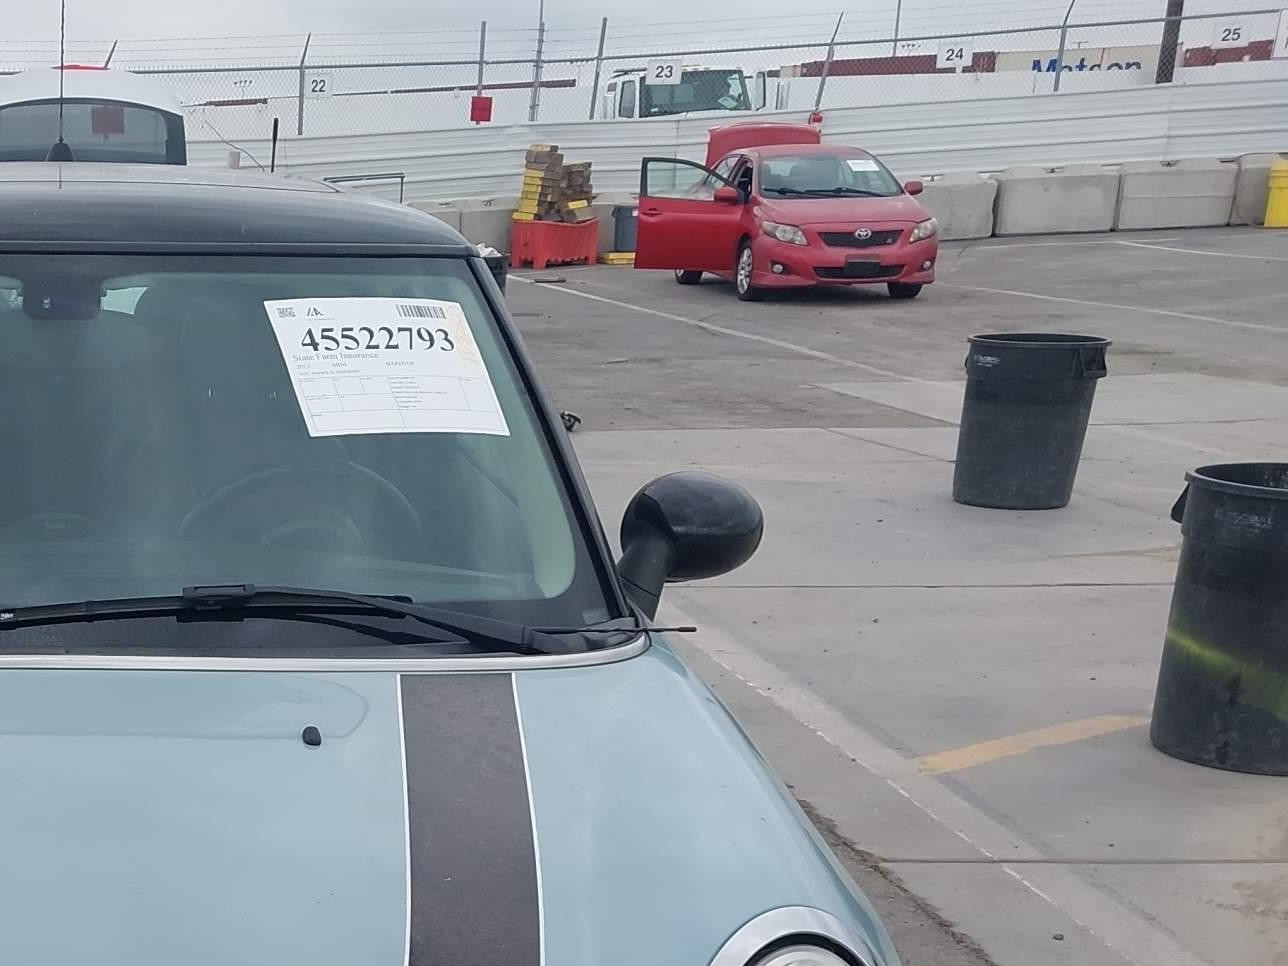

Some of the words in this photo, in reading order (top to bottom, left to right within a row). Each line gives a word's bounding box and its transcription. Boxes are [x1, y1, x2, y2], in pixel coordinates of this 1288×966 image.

[1220, 27, 1242, 42] 25
[945, 47, 964, 61] 24
[655, 65, 674, 78] 23
[311, 79, 326, 93] 22
[300, 326, 456, 352] 45522793
[292, 353, 314, 362] State
[315, 352, 338, 361] Farm
[338, 351, 380, 360] Insurance
